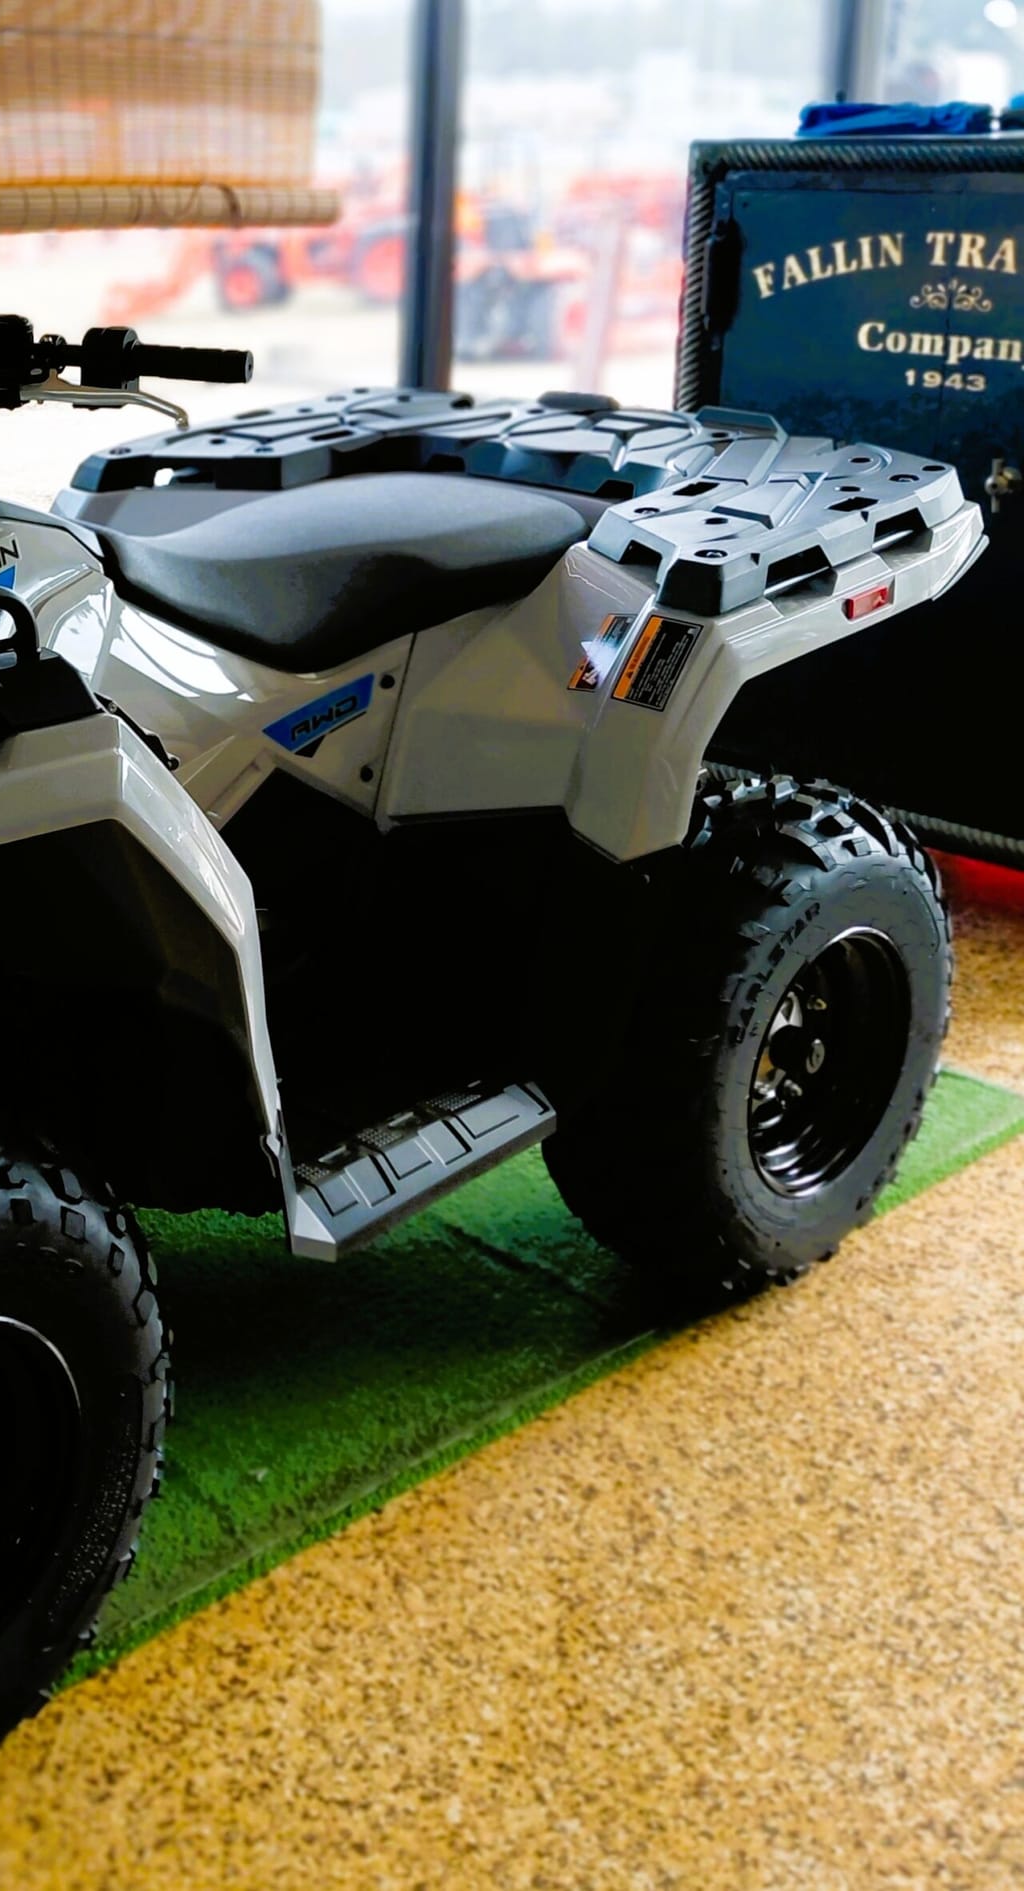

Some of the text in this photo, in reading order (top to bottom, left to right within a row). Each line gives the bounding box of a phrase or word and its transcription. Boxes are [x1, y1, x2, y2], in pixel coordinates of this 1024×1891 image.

[752, 231, 1017, 299] FALLIN TRA
[857, 322, 1024, 371] Compan
[905, 369, 986, 391] 1943
[290, 695, 358, 741] AWD
